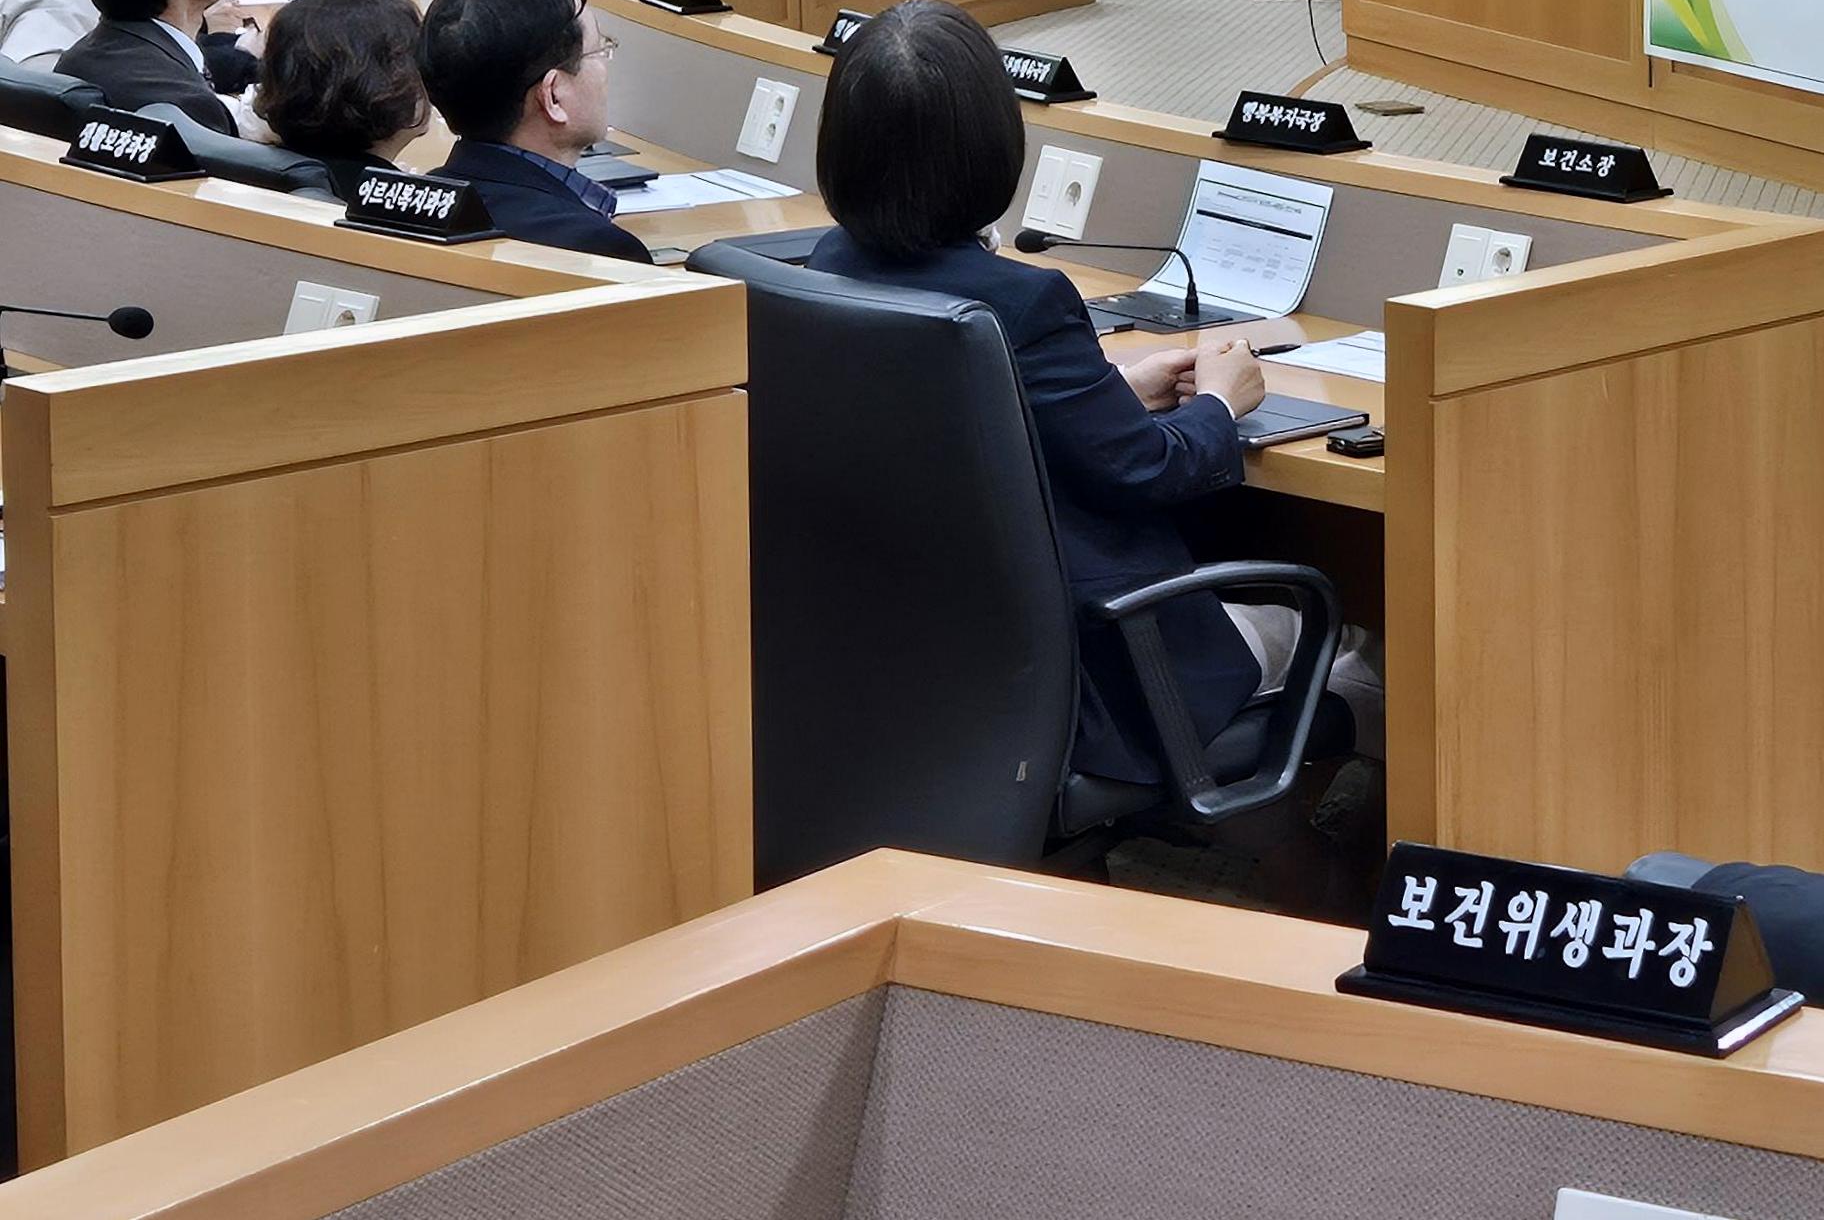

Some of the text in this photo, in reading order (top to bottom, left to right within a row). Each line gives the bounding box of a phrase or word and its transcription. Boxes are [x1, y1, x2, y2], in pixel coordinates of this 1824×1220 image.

[1538, 148, 1616, 178] 보건소장
[358, 177, 457, 219] 어르신복지과장
[1387, 875, 1715, 988] 보건위생과장
